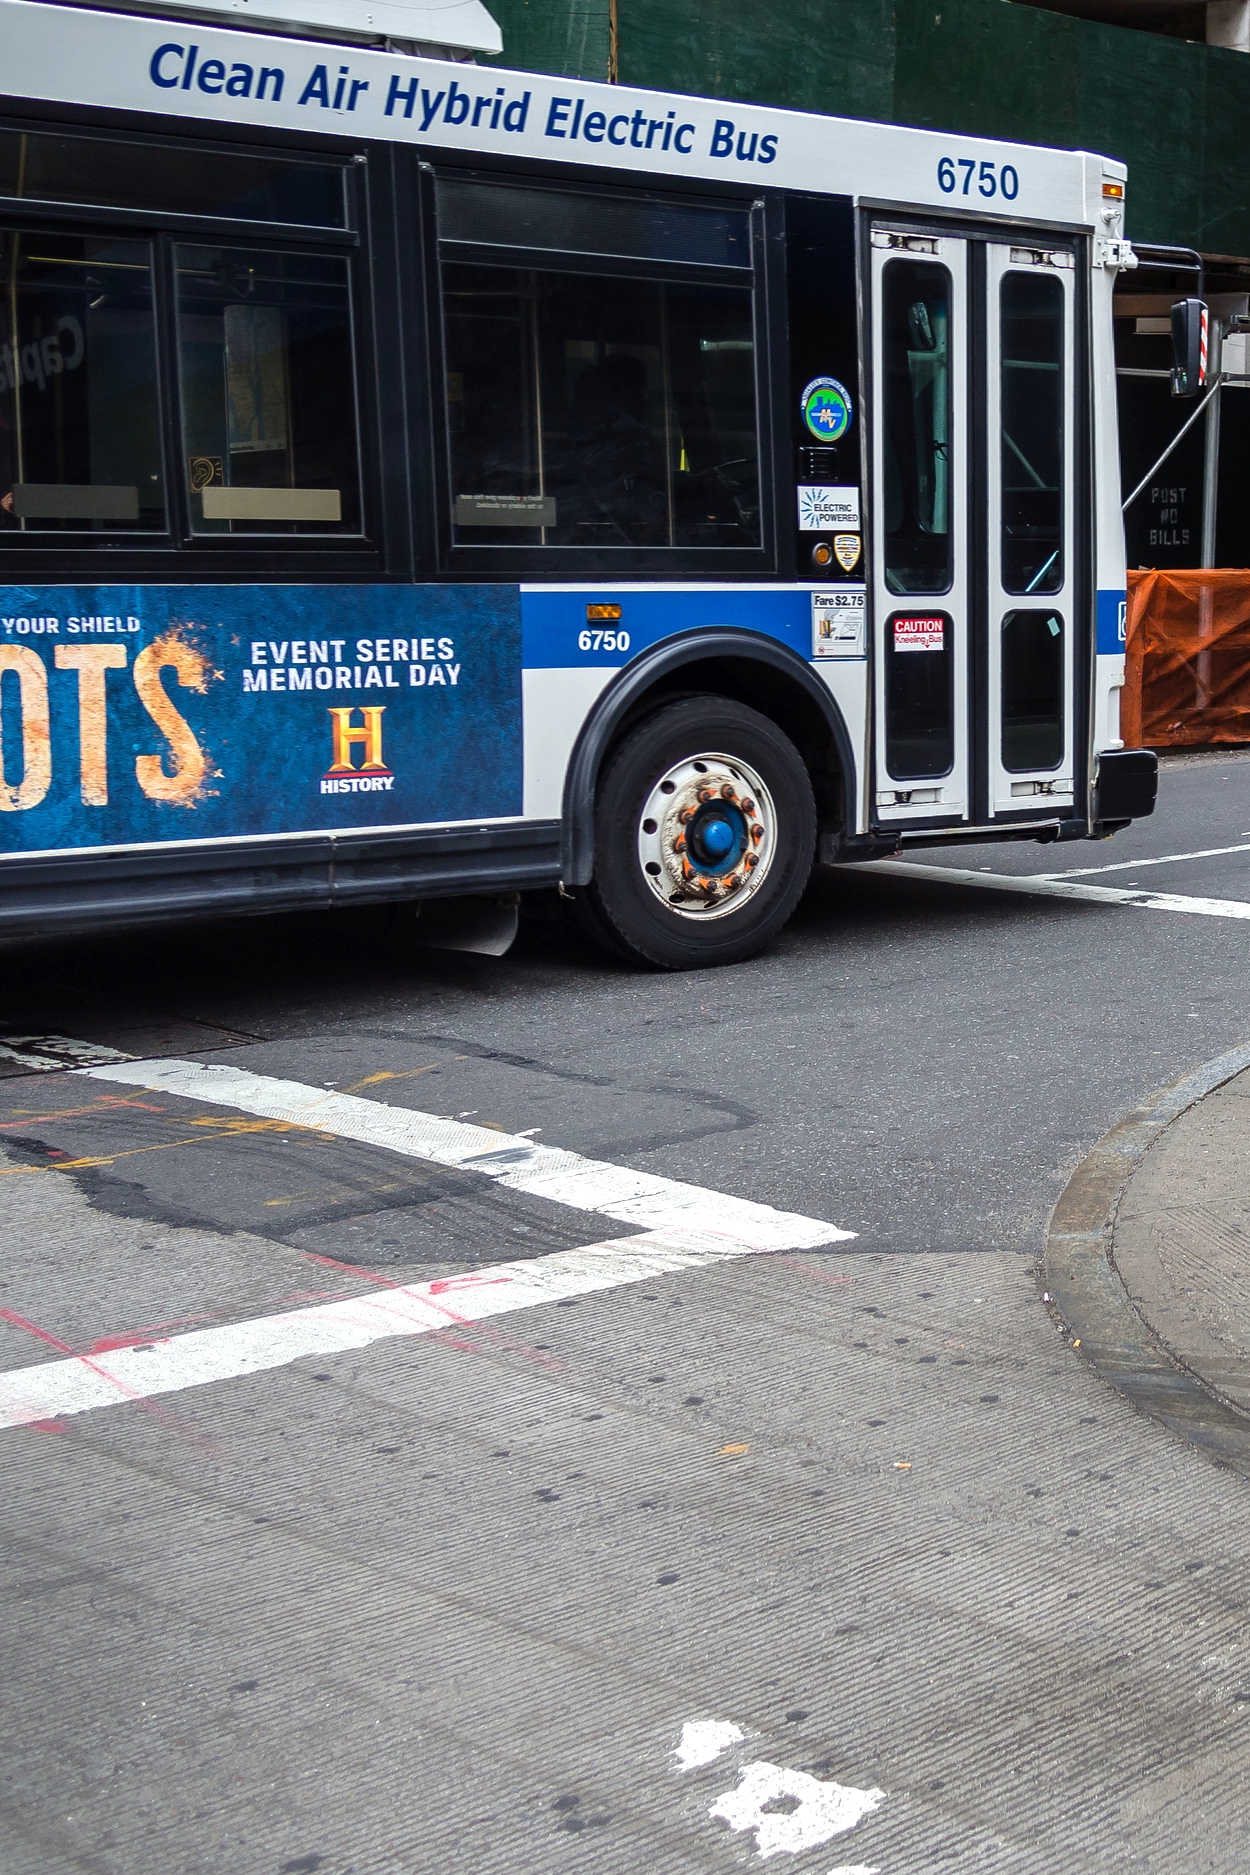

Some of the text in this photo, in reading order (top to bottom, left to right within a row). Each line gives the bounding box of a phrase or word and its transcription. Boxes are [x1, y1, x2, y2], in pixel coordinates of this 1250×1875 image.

[149, 43, 779, 164] Clean Air Hybrid Electric Bus
[937, 156, 1019, 201] 6750
[1151, 487, 1187, 503] POST
[813, 503, 852, 512] ELECTRIC
[819, 513, 858, 522] POWERED
[1160, 508, 1178, 525] NO
[1149, 529, 1190, 546] BILLS
[814, 595, 864, 606] Fare $2.75
[1, 616, 141, 634] YOUR SHIELD
[895, 620, 943, 632] CAUTION
[578, 630, 631, 652] 6750
[894, 634, 943, 645] Kneeling Bus
[251, 637, 454, 665] EVENT SERIES
[242, 663, 461, 692] MEMORIAL DAY
[326, 706, 387, 772] H
[320, 776, 395, 795] HISTORY
